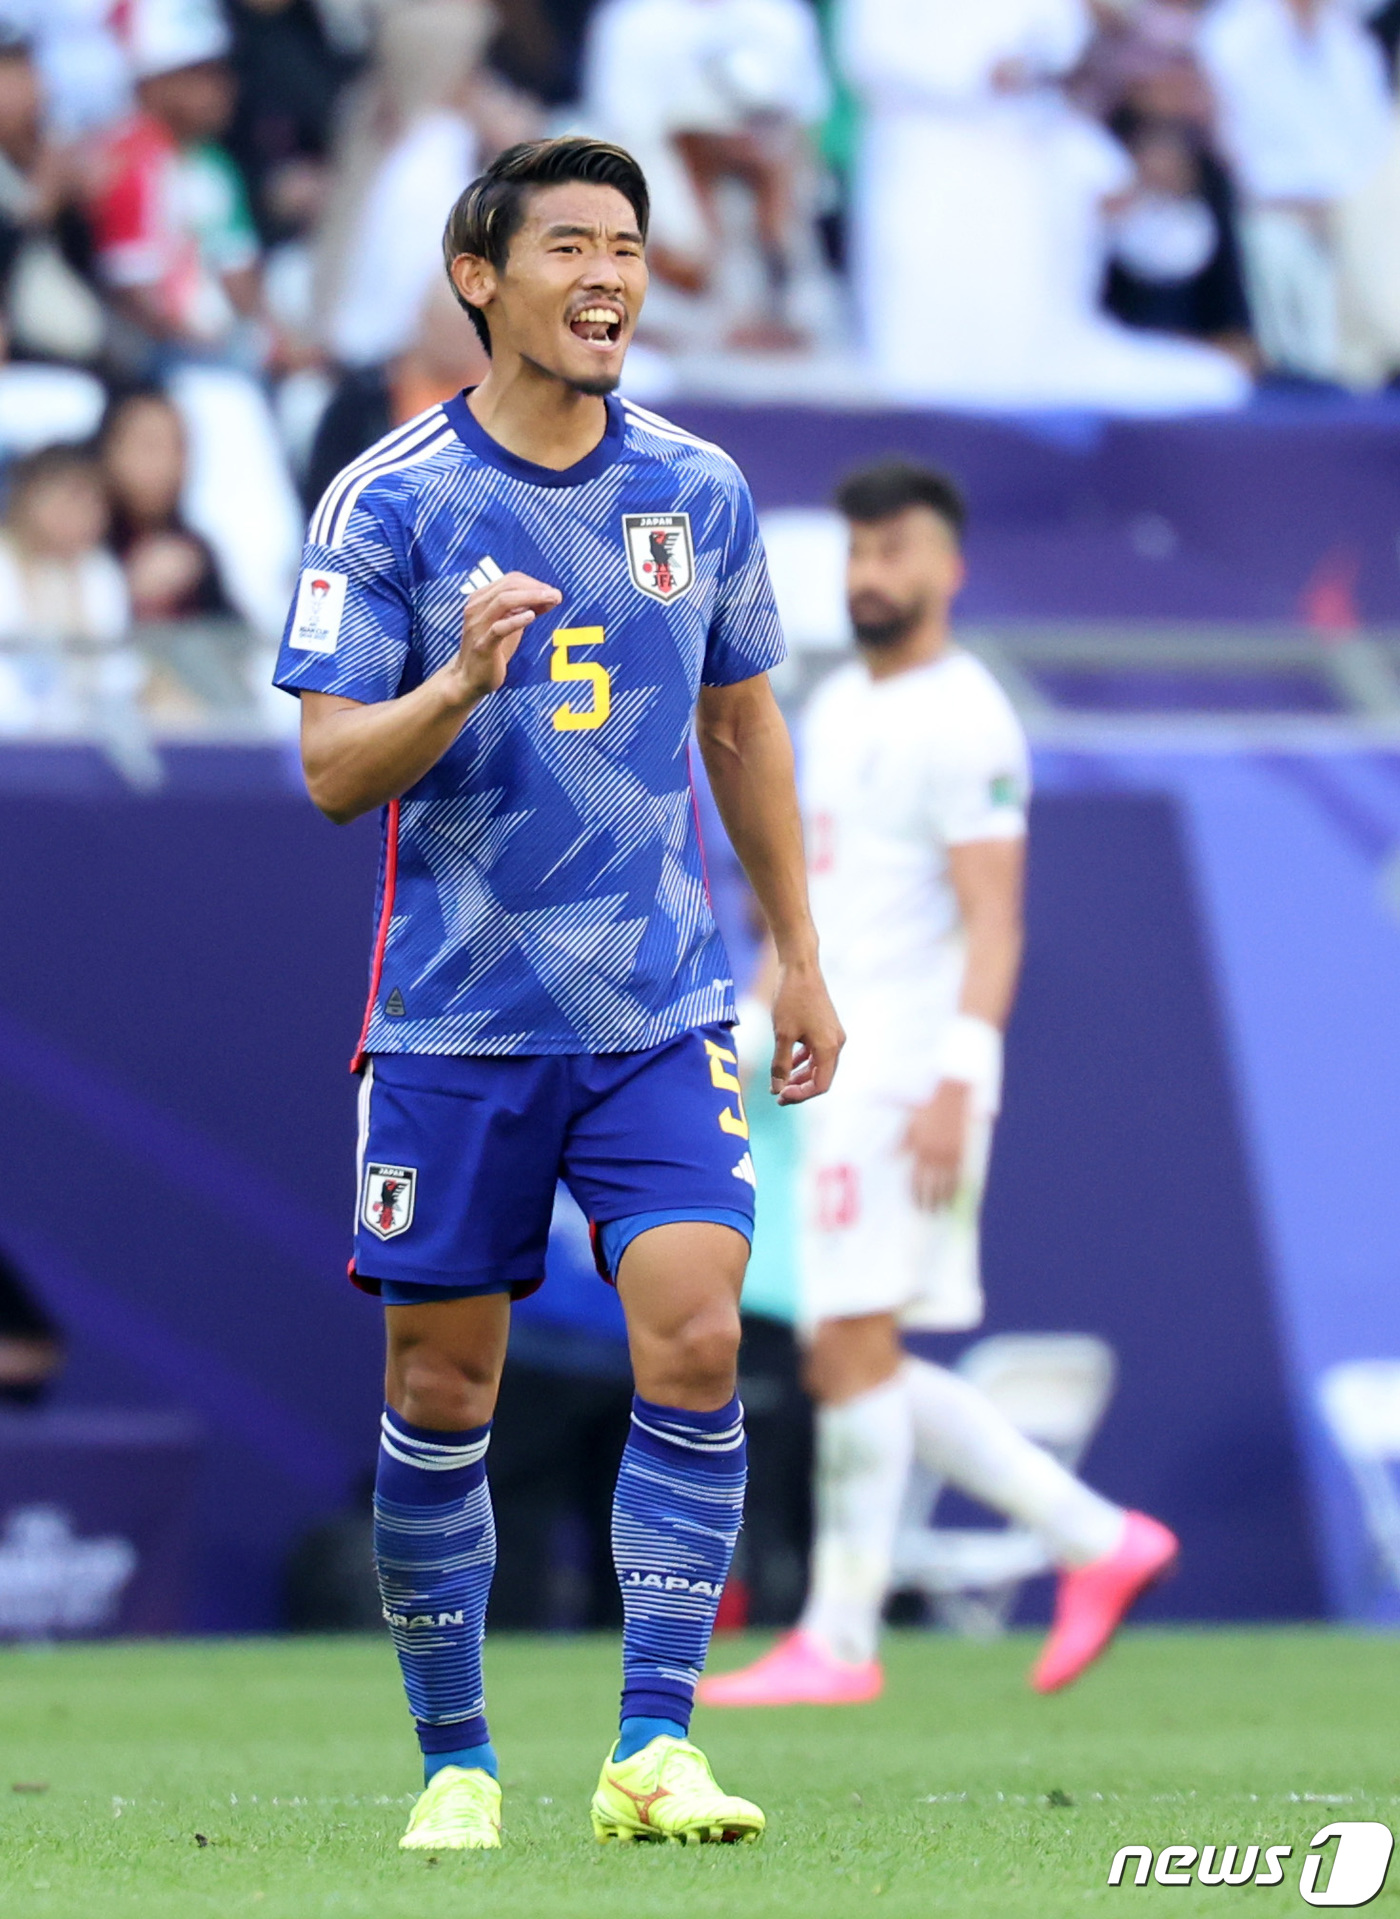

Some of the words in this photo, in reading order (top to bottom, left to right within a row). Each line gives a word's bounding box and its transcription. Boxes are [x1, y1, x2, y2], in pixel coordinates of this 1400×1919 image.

[640, 517, 673, 527] JAPAN
[651, 574, 677, 588] JFA
[550, 625, 611, 732] 5
[704, 1038, 749, 1140] 5
[378, 1167, 405, 1178] JAPAN
